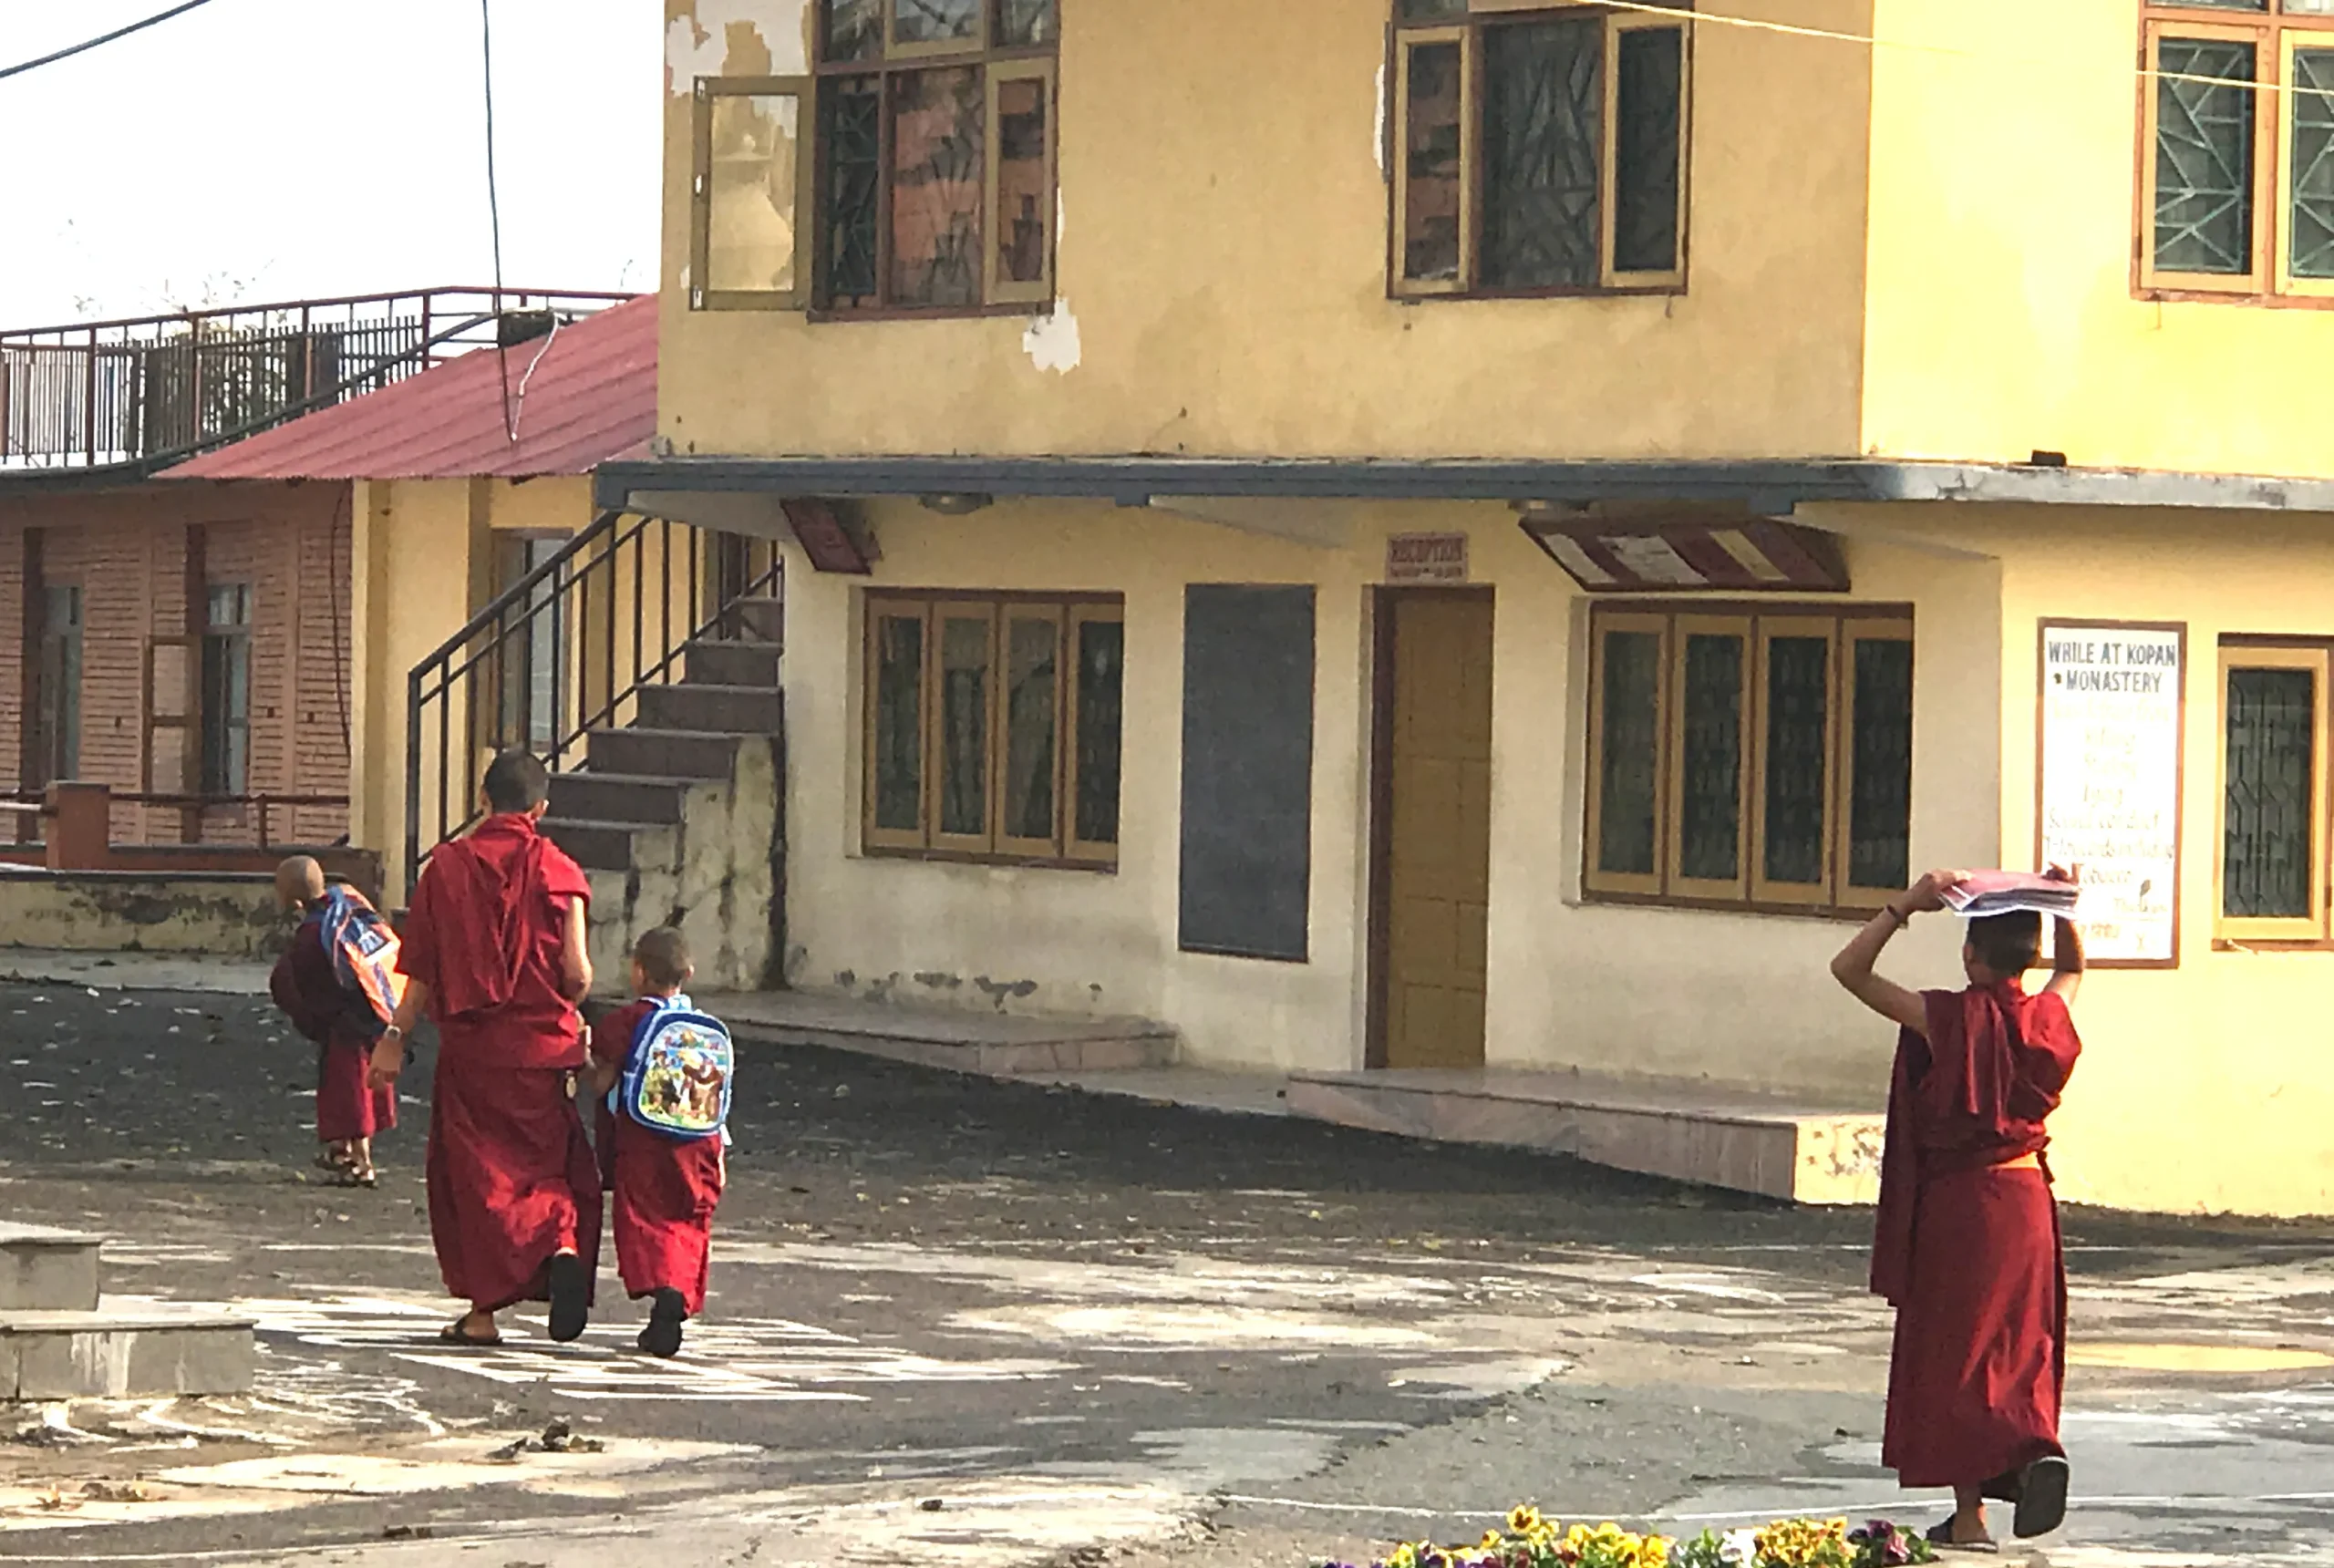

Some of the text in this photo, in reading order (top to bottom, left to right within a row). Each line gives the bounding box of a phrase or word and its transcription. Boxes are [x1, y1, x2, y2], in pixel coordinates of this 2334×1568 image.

[1389, 538, 1463, 562] RECEPTION
[2049, 641, 2176, 666] WHILE AT KOPAN
[2066, 669, 2163, 693] MONASTERY
